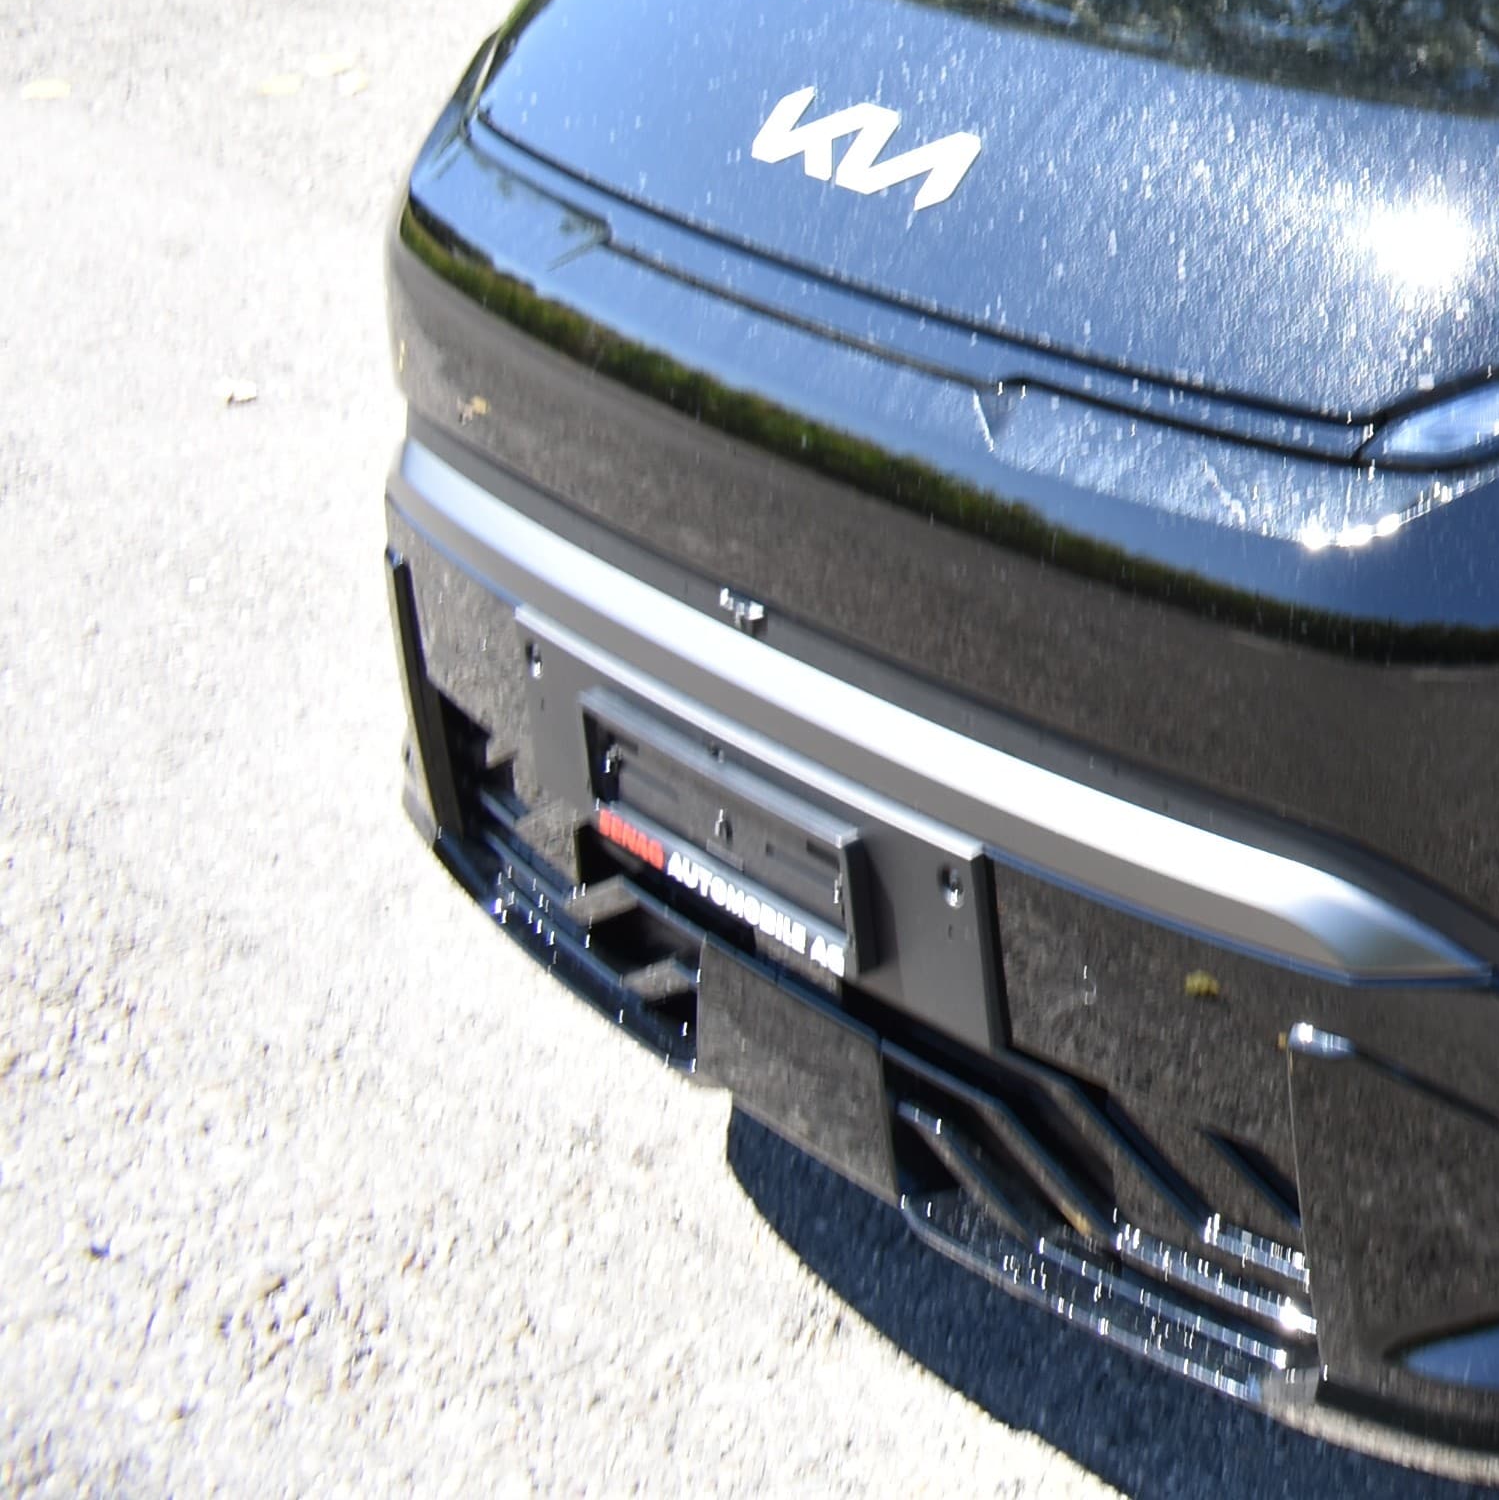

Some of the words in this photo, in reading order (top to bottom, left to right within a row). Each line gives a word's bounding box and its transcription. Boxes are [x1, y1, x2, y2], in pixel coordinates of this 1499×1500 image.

[751, 85, 982, 211] KIA
[667, 852, 806, 954] AUTOMOBILE
[810, 935, 845, 977] AG
